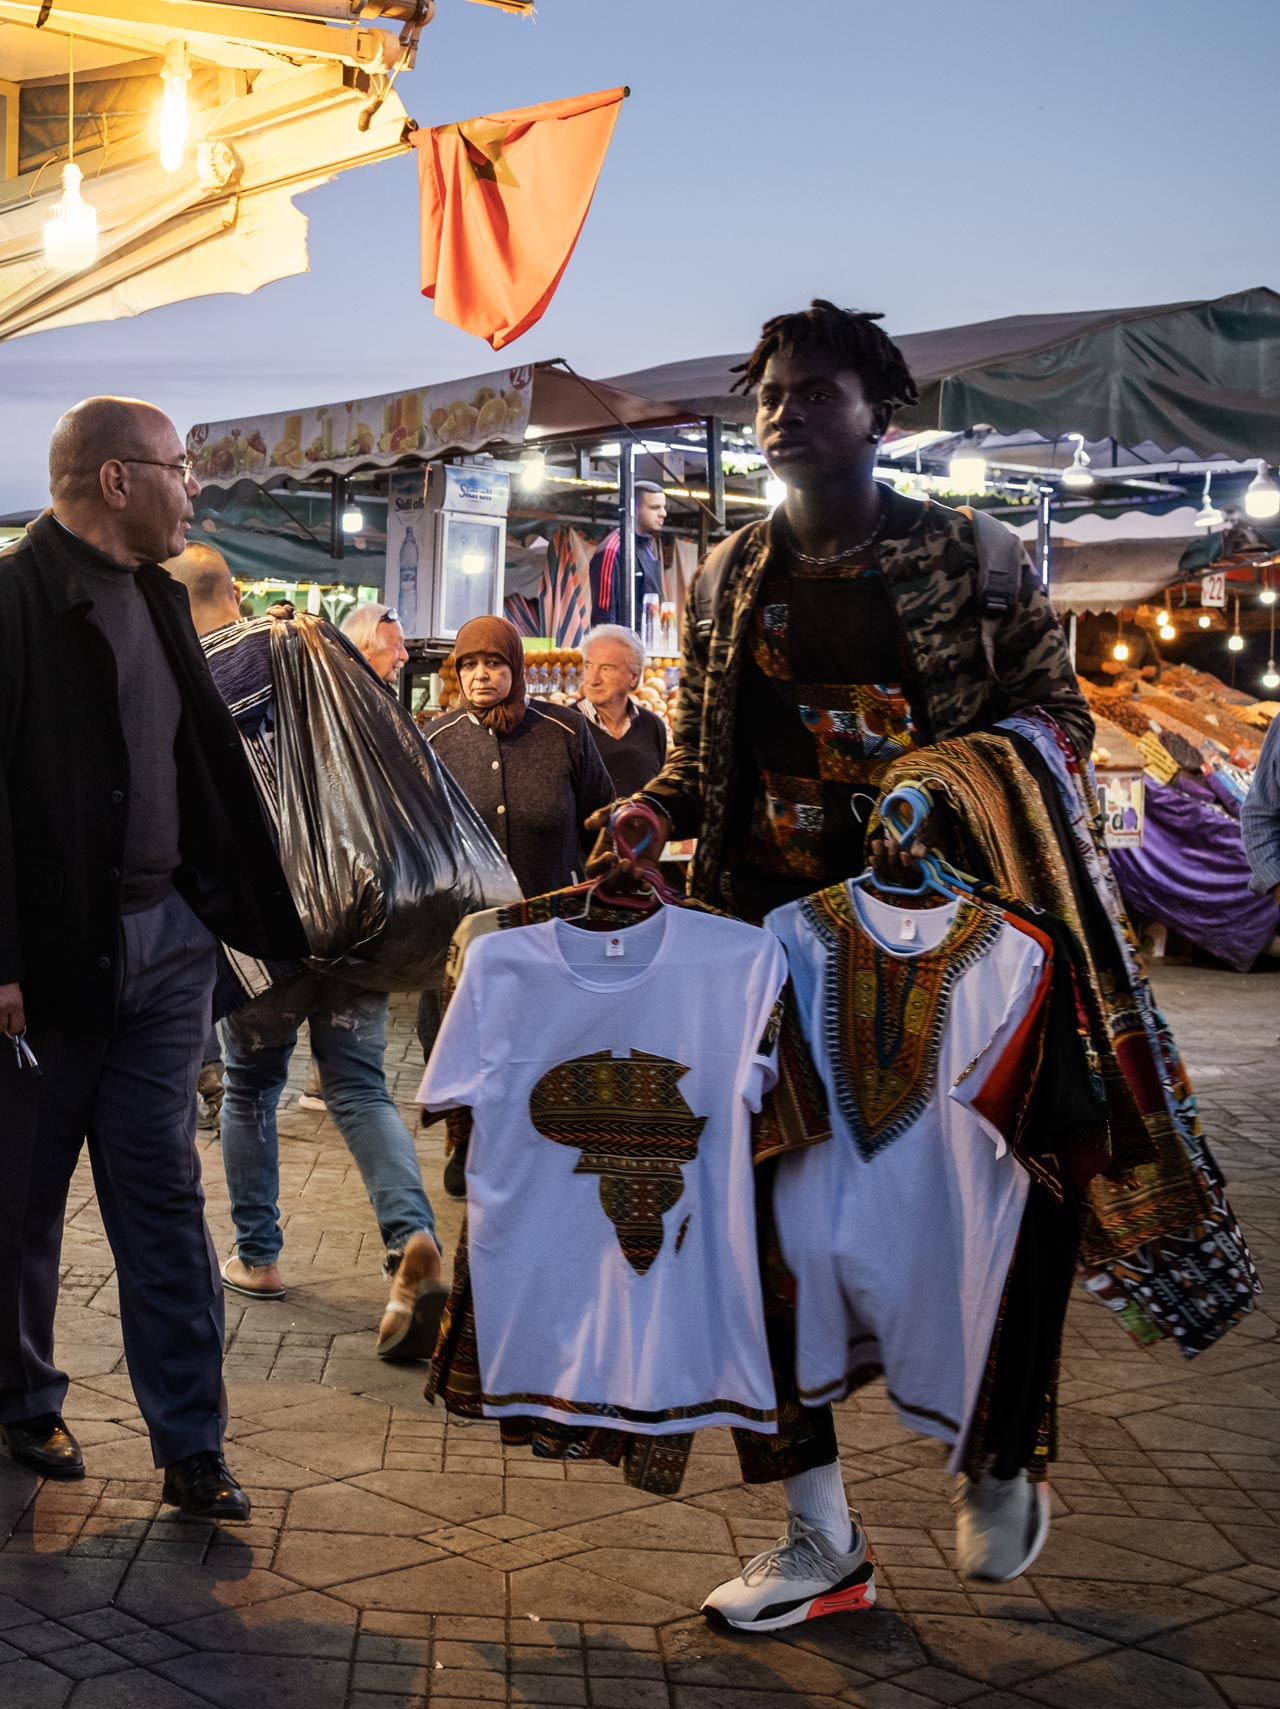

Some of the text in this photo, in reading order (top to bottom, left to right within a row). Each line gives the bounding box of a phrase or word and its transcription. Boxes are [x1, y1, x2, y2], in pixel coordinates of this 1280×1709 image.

[459, 484, 492, 501] Sidi ali
[395, 498, 412, 511] Sidi
